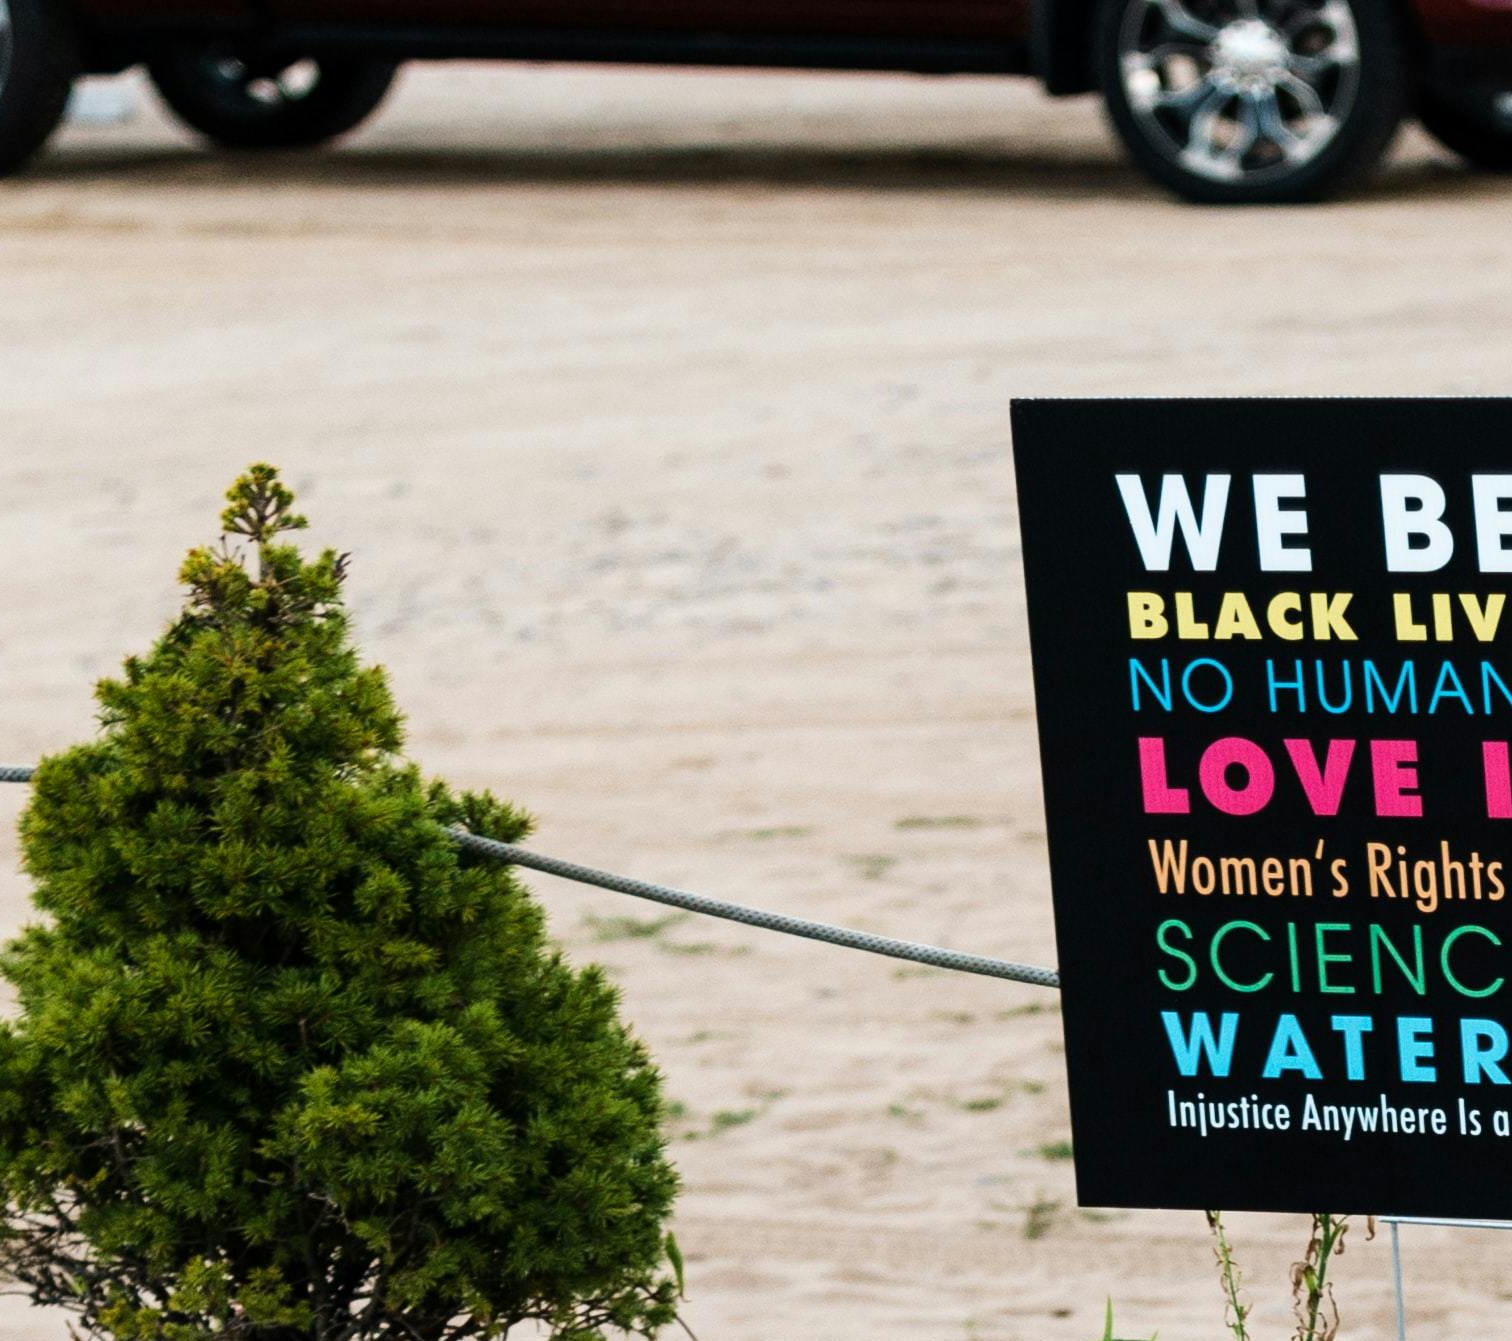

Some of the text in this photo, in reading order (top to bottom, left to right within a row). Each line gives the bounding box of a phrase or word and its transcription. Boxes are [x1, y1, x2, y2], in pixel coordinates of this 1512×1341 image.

[1114, 473, 1313, 572] WE
[1126, 591, 1359, 641] BLACK
[1128, 657, 1234, 713] NO
[1138, 736, 1423, 818] LOVE
[1147, 838, 1349, 898] Women's
[1366, 840, 1505, 913] Rights
[1160, 1010, 1512, 1085] WATER
[1167, 1089, 1291, 1137] Injustice
[1301, 1093, 1447, 1141] Anywhere
[1458, 1097, 1482, 1136] Is
[1492, 1110, 1510, 1137] a
